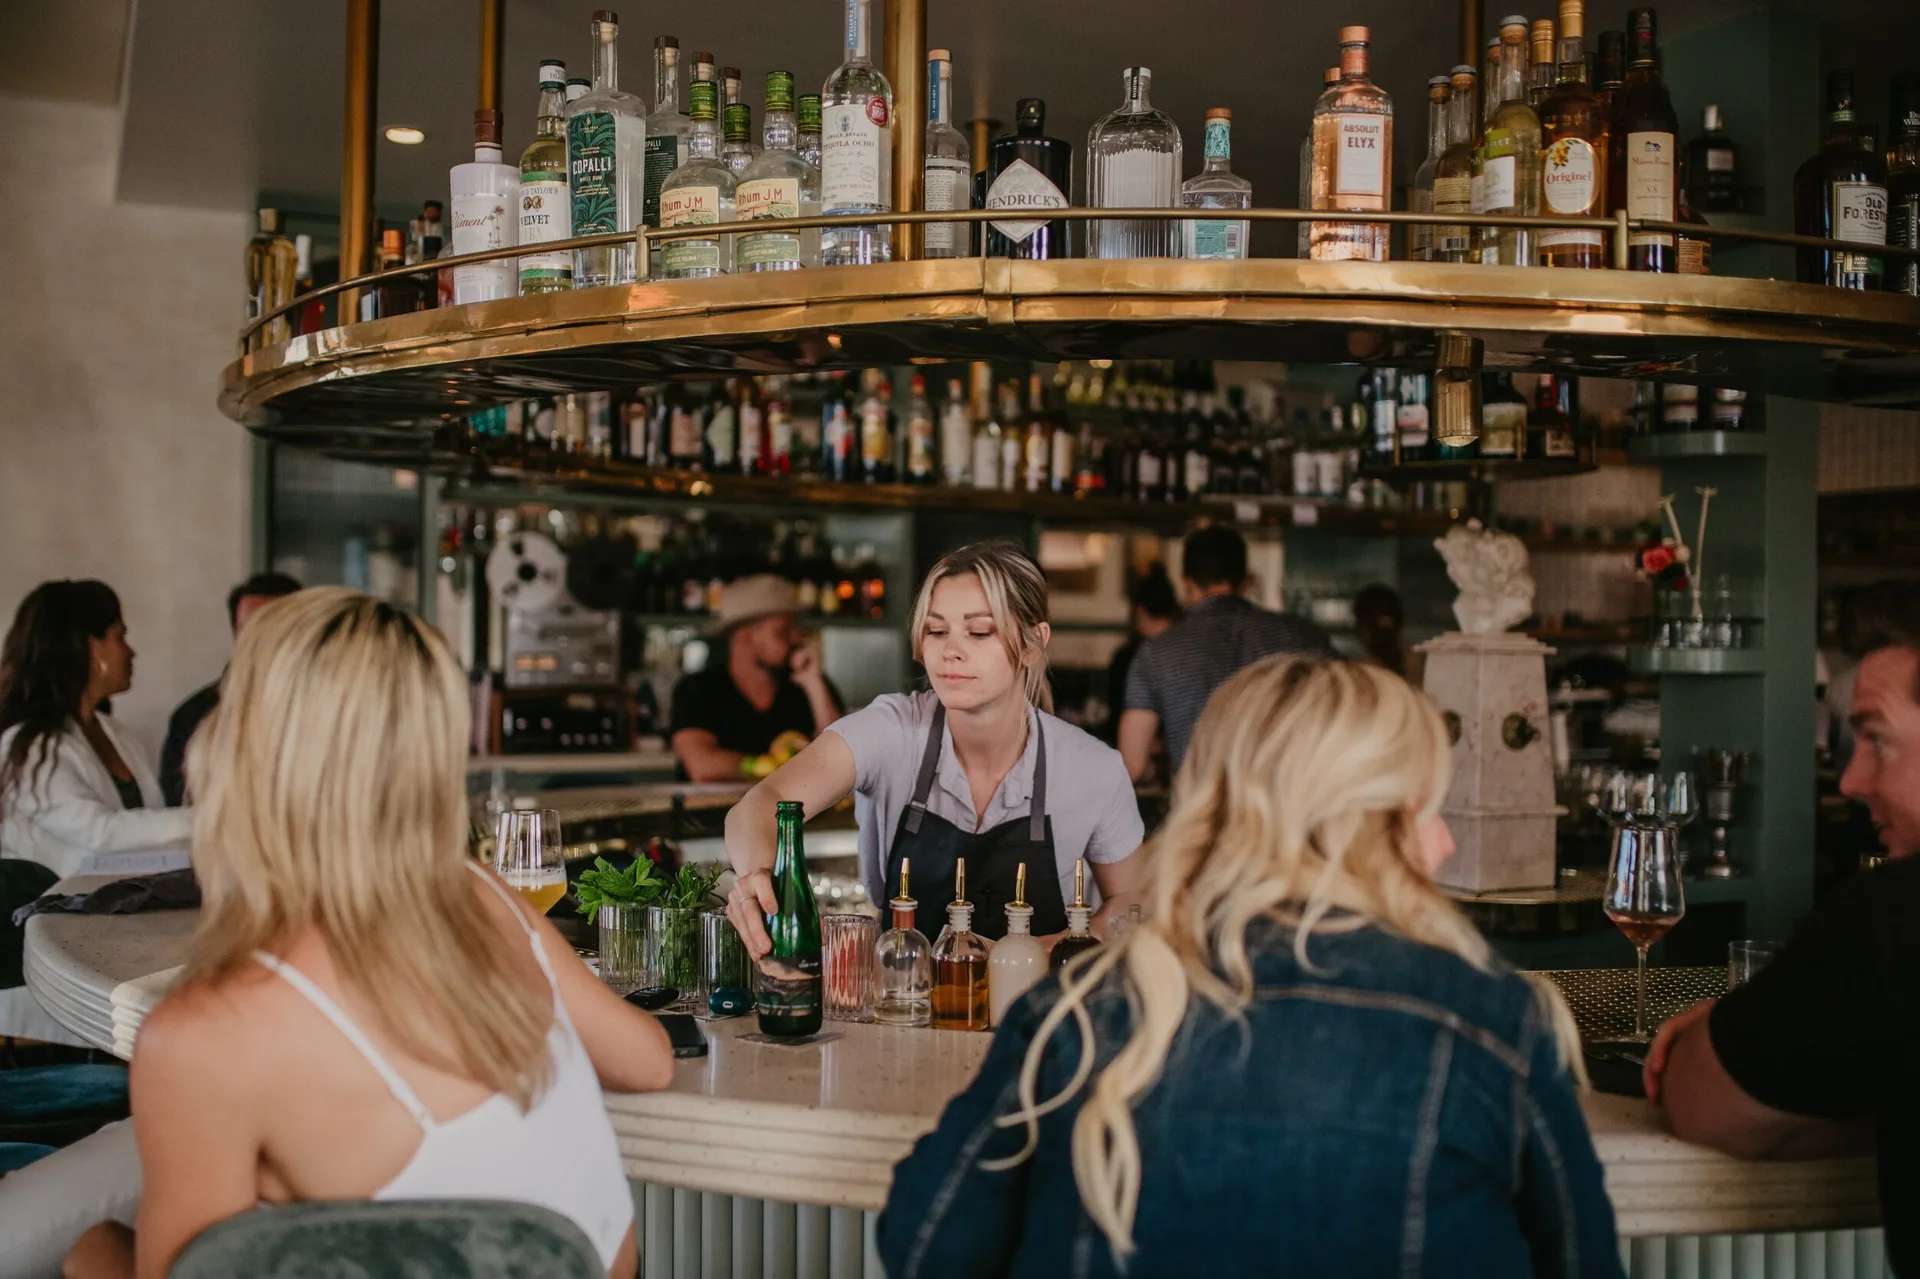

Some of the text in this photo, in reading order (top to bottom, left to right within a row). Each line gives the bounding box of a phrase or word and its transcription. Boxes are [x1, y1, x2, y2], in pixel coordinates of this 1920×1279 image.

[1343, 124, 1380, 134] ABSOLUT
[823, 141, 850, 151] TEQUILA
[1347, 136, 1375, 148] ELYX
[573, 156, 611, 175] COPALLI
[531, 187, 559, 195] TAYLOR'S
[738, 188, 783, 205] Rhum J.M
[661, 196, 703, 214] Rhum J.M
[987, 194, 1060, 209] HENDRICK'S
[1866, 197, 1882, 209] OLD
[521, 215, 551, 226] VELVET
[1843, 206, 1888, 223] FORESTE
